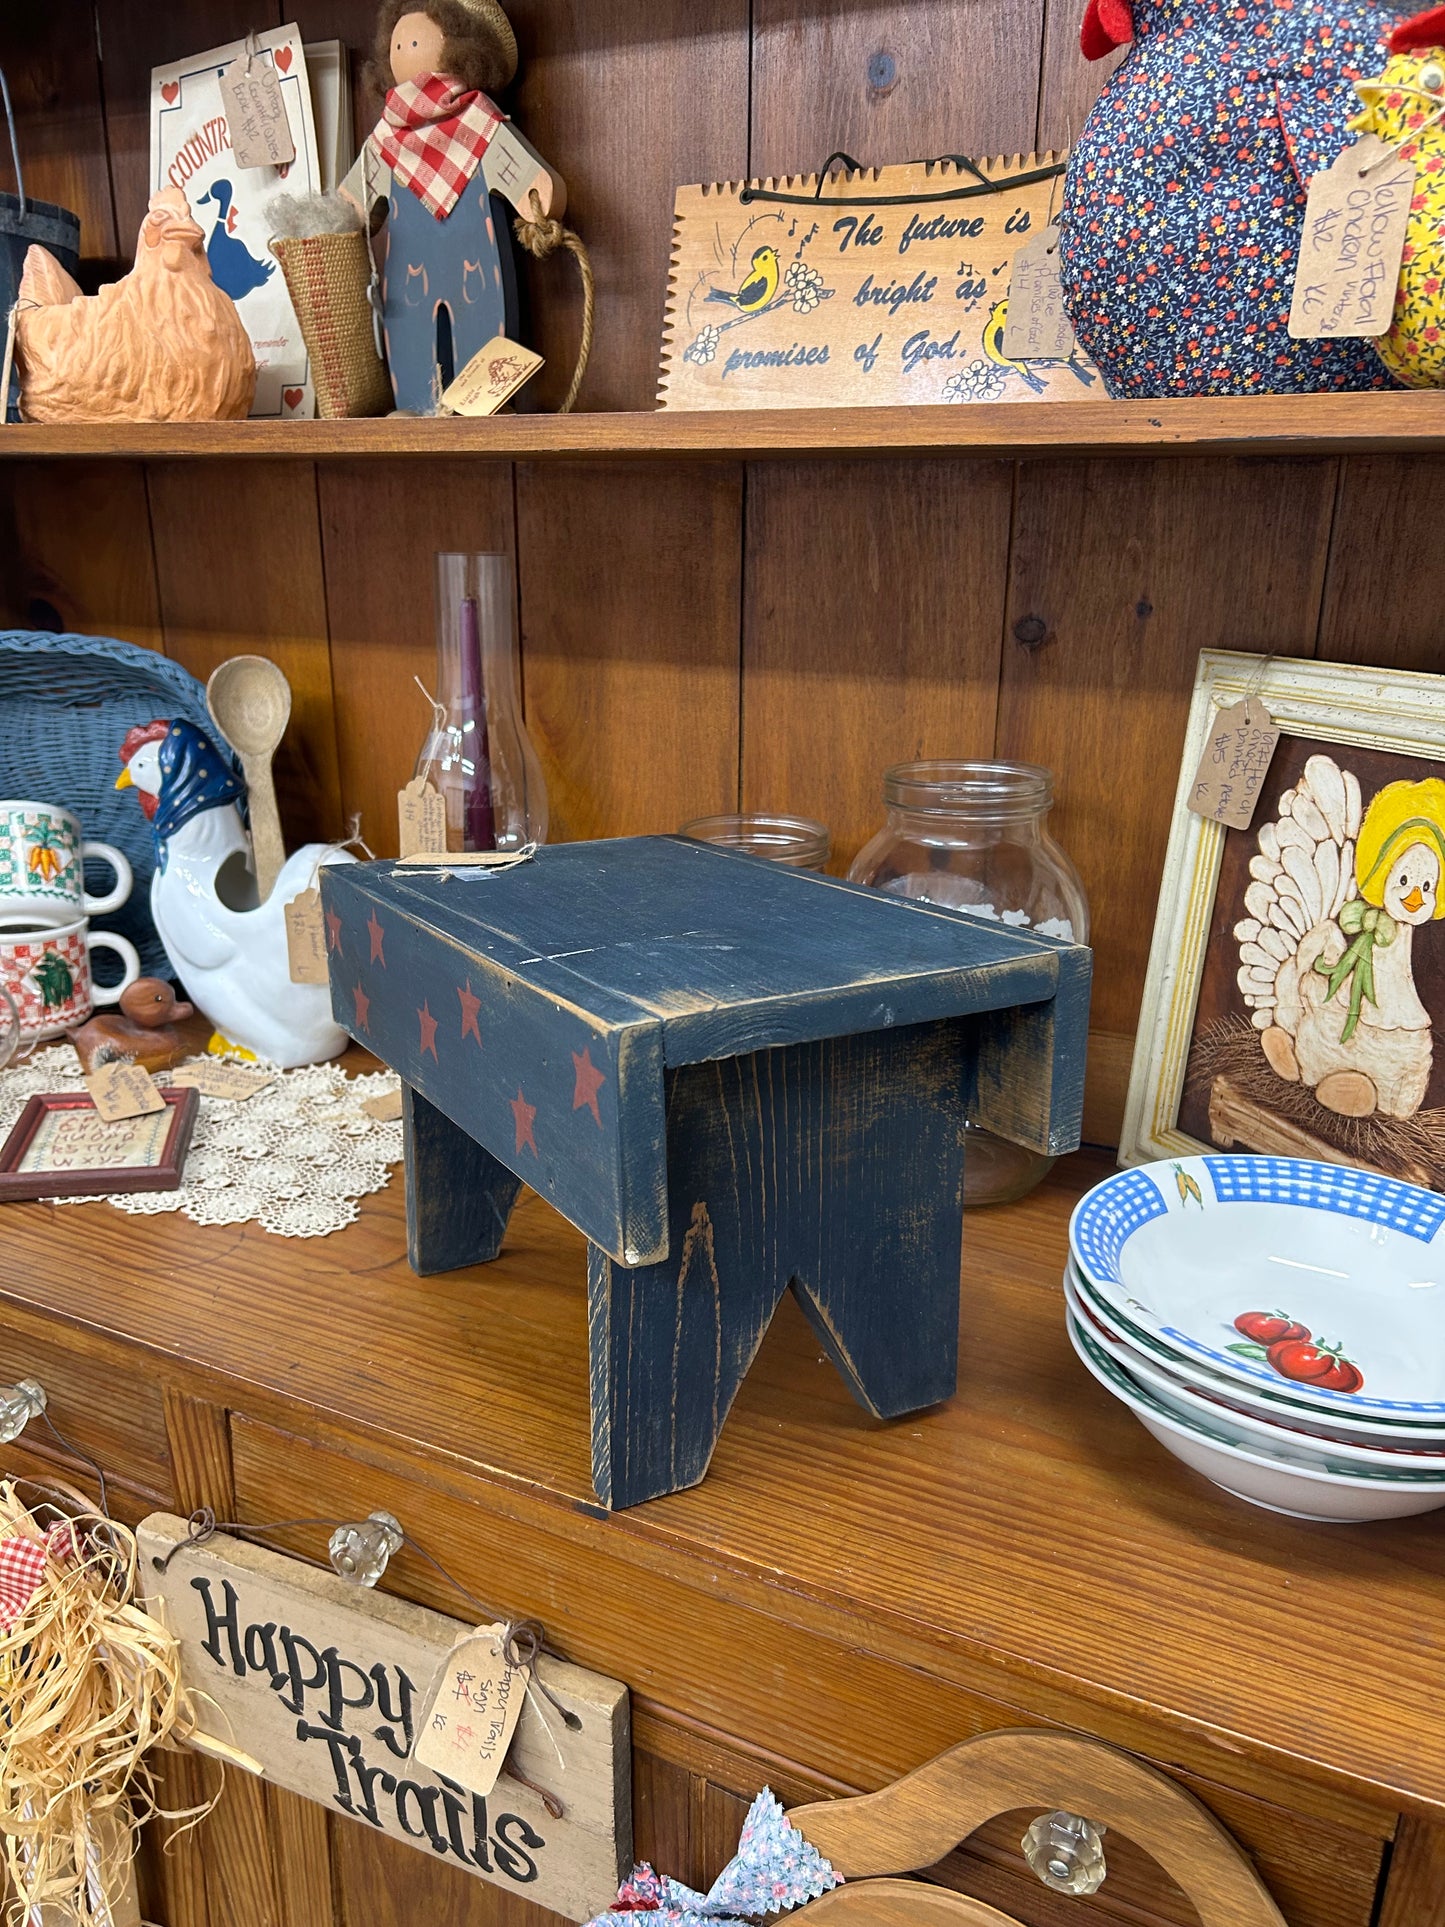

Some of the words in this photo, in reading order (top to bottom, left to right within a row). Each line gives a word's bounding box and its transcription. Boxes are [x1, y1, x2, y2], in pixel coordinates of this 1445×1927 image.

[168, 116, 233, 190] COUNTR
[832, 212, 884, 252] The
[899, 212, 986, 255] future
[1003, 207, 1032, 234] is
[1312, 208, 1342, 252] $12
[1334, 189, 1370, 271] Chicken
[1367, 170, 1411, 256] Yellow
[853, 270, 937, 316] bright
[956, 276, 988, 301] as
[1016, 260, 1035, 289] $14
[1355, 262, 1386, 324] Floral
[721, 341, 831, 379] promises
[853, 338, 881, 373] of
[901, 329, 967, 374] God.
[1213, 733, 1232, 764] $15
[1230, 727, 1248, 778] Painted
[1256, 731, 1275, 767] 1977
[1244, 768, 1264, 795] Hen
[190, 1576, 417, 1759] Happy
[493, 1663, 519, 1710] Happy
[480, 1710, 506, 1760] Trails
[296, 1718, 546, 1883] Trails
